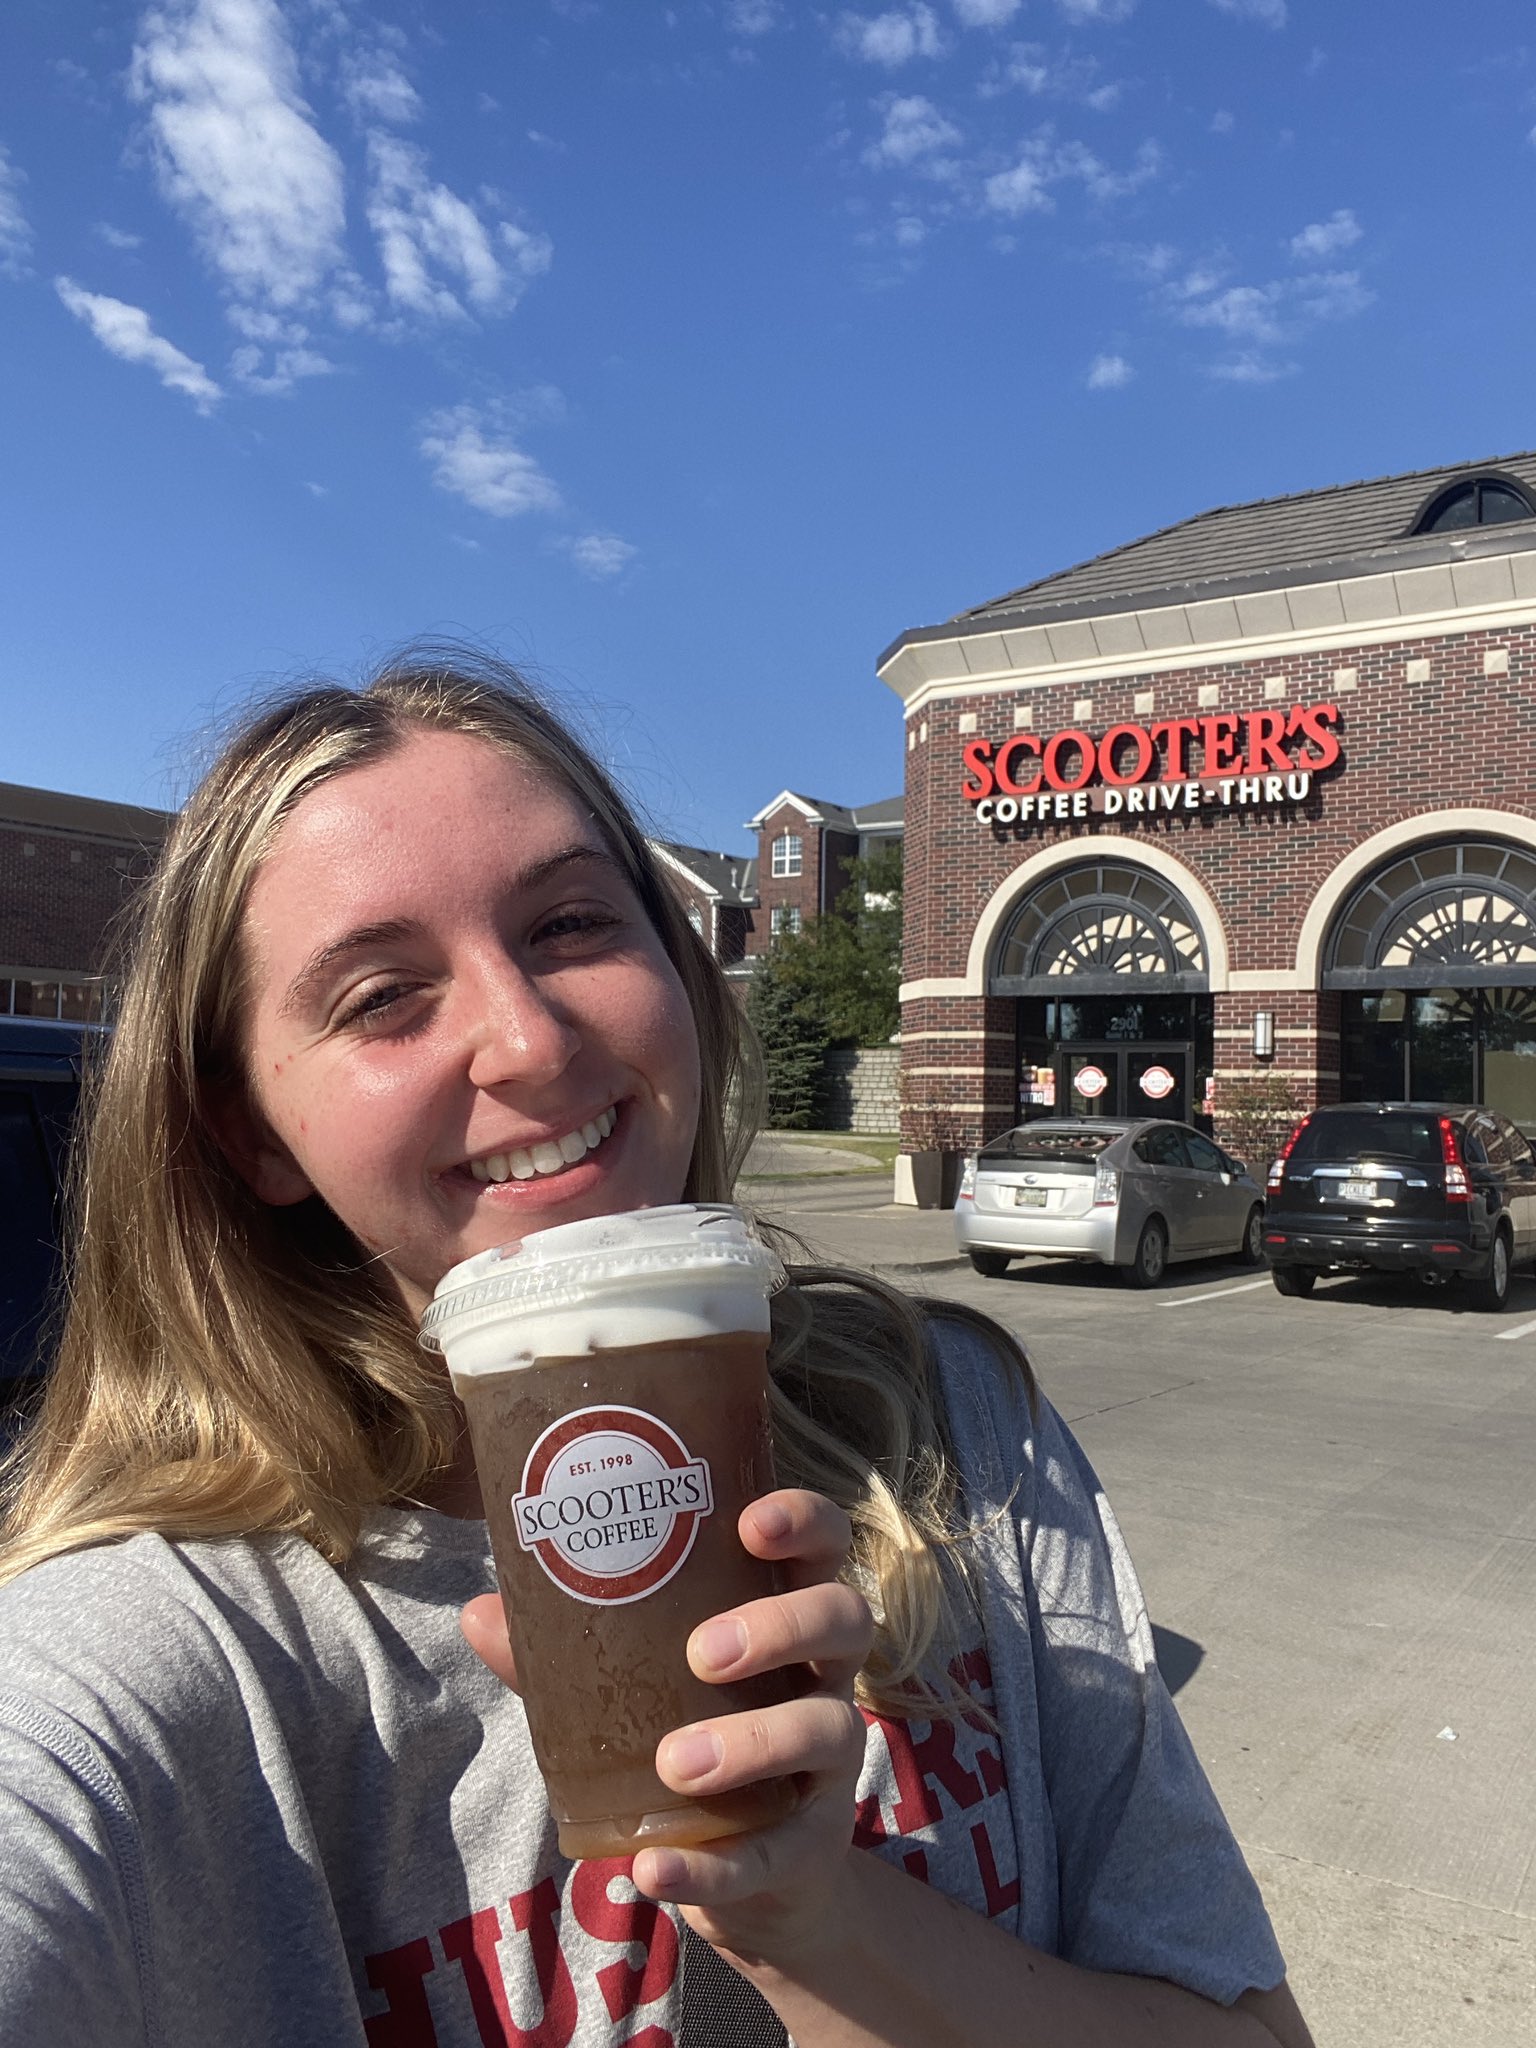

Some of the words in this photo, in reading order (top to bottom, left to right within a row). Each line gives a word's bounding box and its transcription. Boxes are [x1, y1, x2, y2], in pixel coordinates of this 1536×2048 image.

[962, 704, 1340, 801] SCOOTER'S
[976, 791, 1088, 825] COFFEE
[1104, 772, 1310, 816] DRIVE-THRU
[570, 1461, 597, 1477] EST.
[600, 1454, 633, 1471] 1998
[523, 1474, 702, 1535] SCOOTER'S
[567, 1517, 658, 1553] COFFEE
